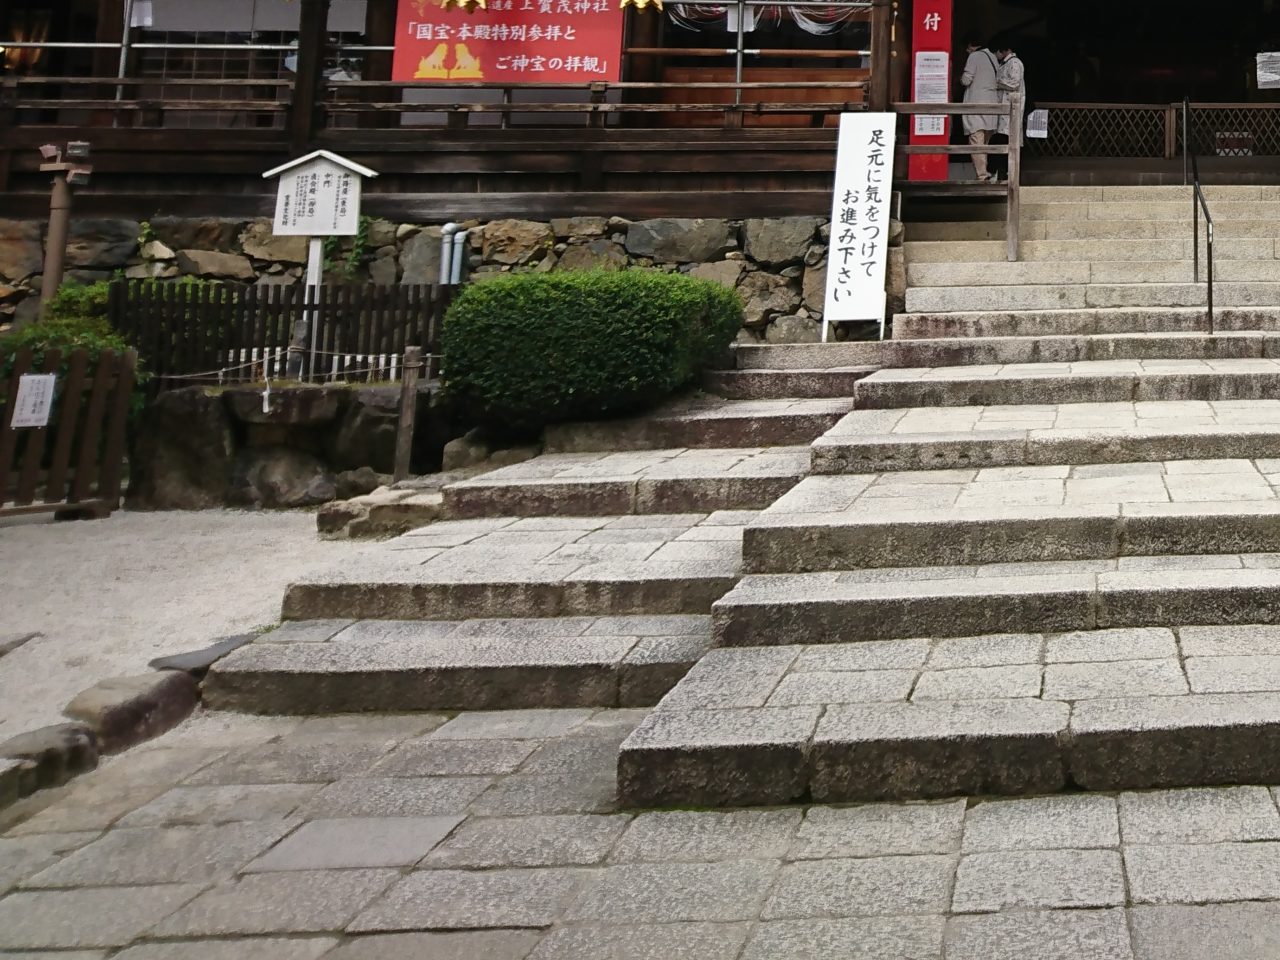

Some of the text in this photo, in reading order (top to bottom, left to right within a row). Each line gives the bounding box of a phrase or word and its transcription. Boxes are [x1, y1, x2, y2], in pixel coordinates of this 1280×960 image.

[834, 189, 860, 302] お進み下さい
[860, 129, 886, 277] 足元に気をつけて
